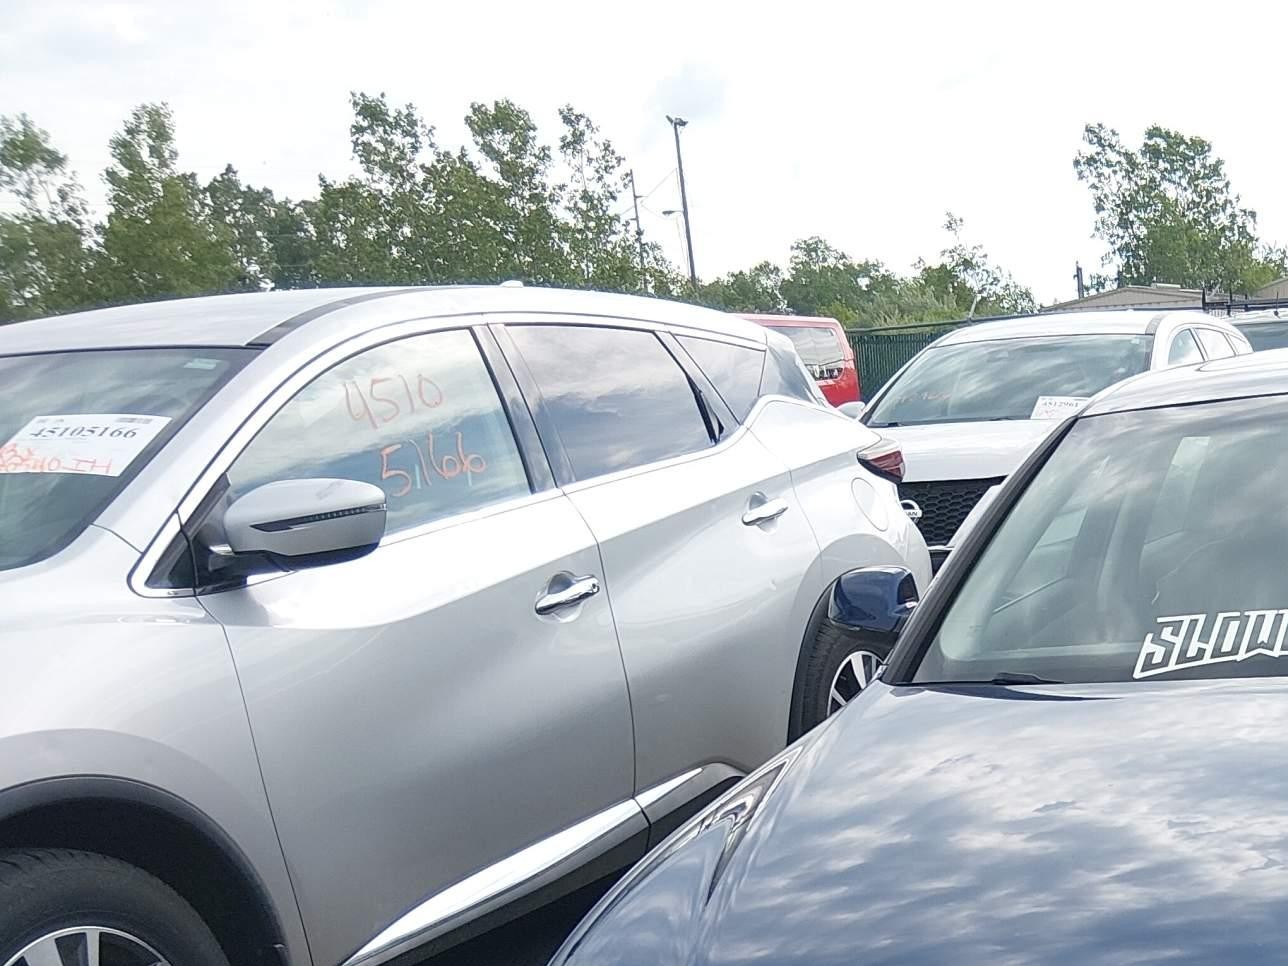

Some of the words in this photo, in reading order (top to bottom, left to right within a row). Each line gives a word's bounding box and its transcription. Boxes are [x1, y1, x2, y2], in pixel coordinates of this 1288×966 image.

[343, 373, 444, 431] 4510
[30, 426, 140, 438] 45105166
[380, 431, 486, 497] 5166
